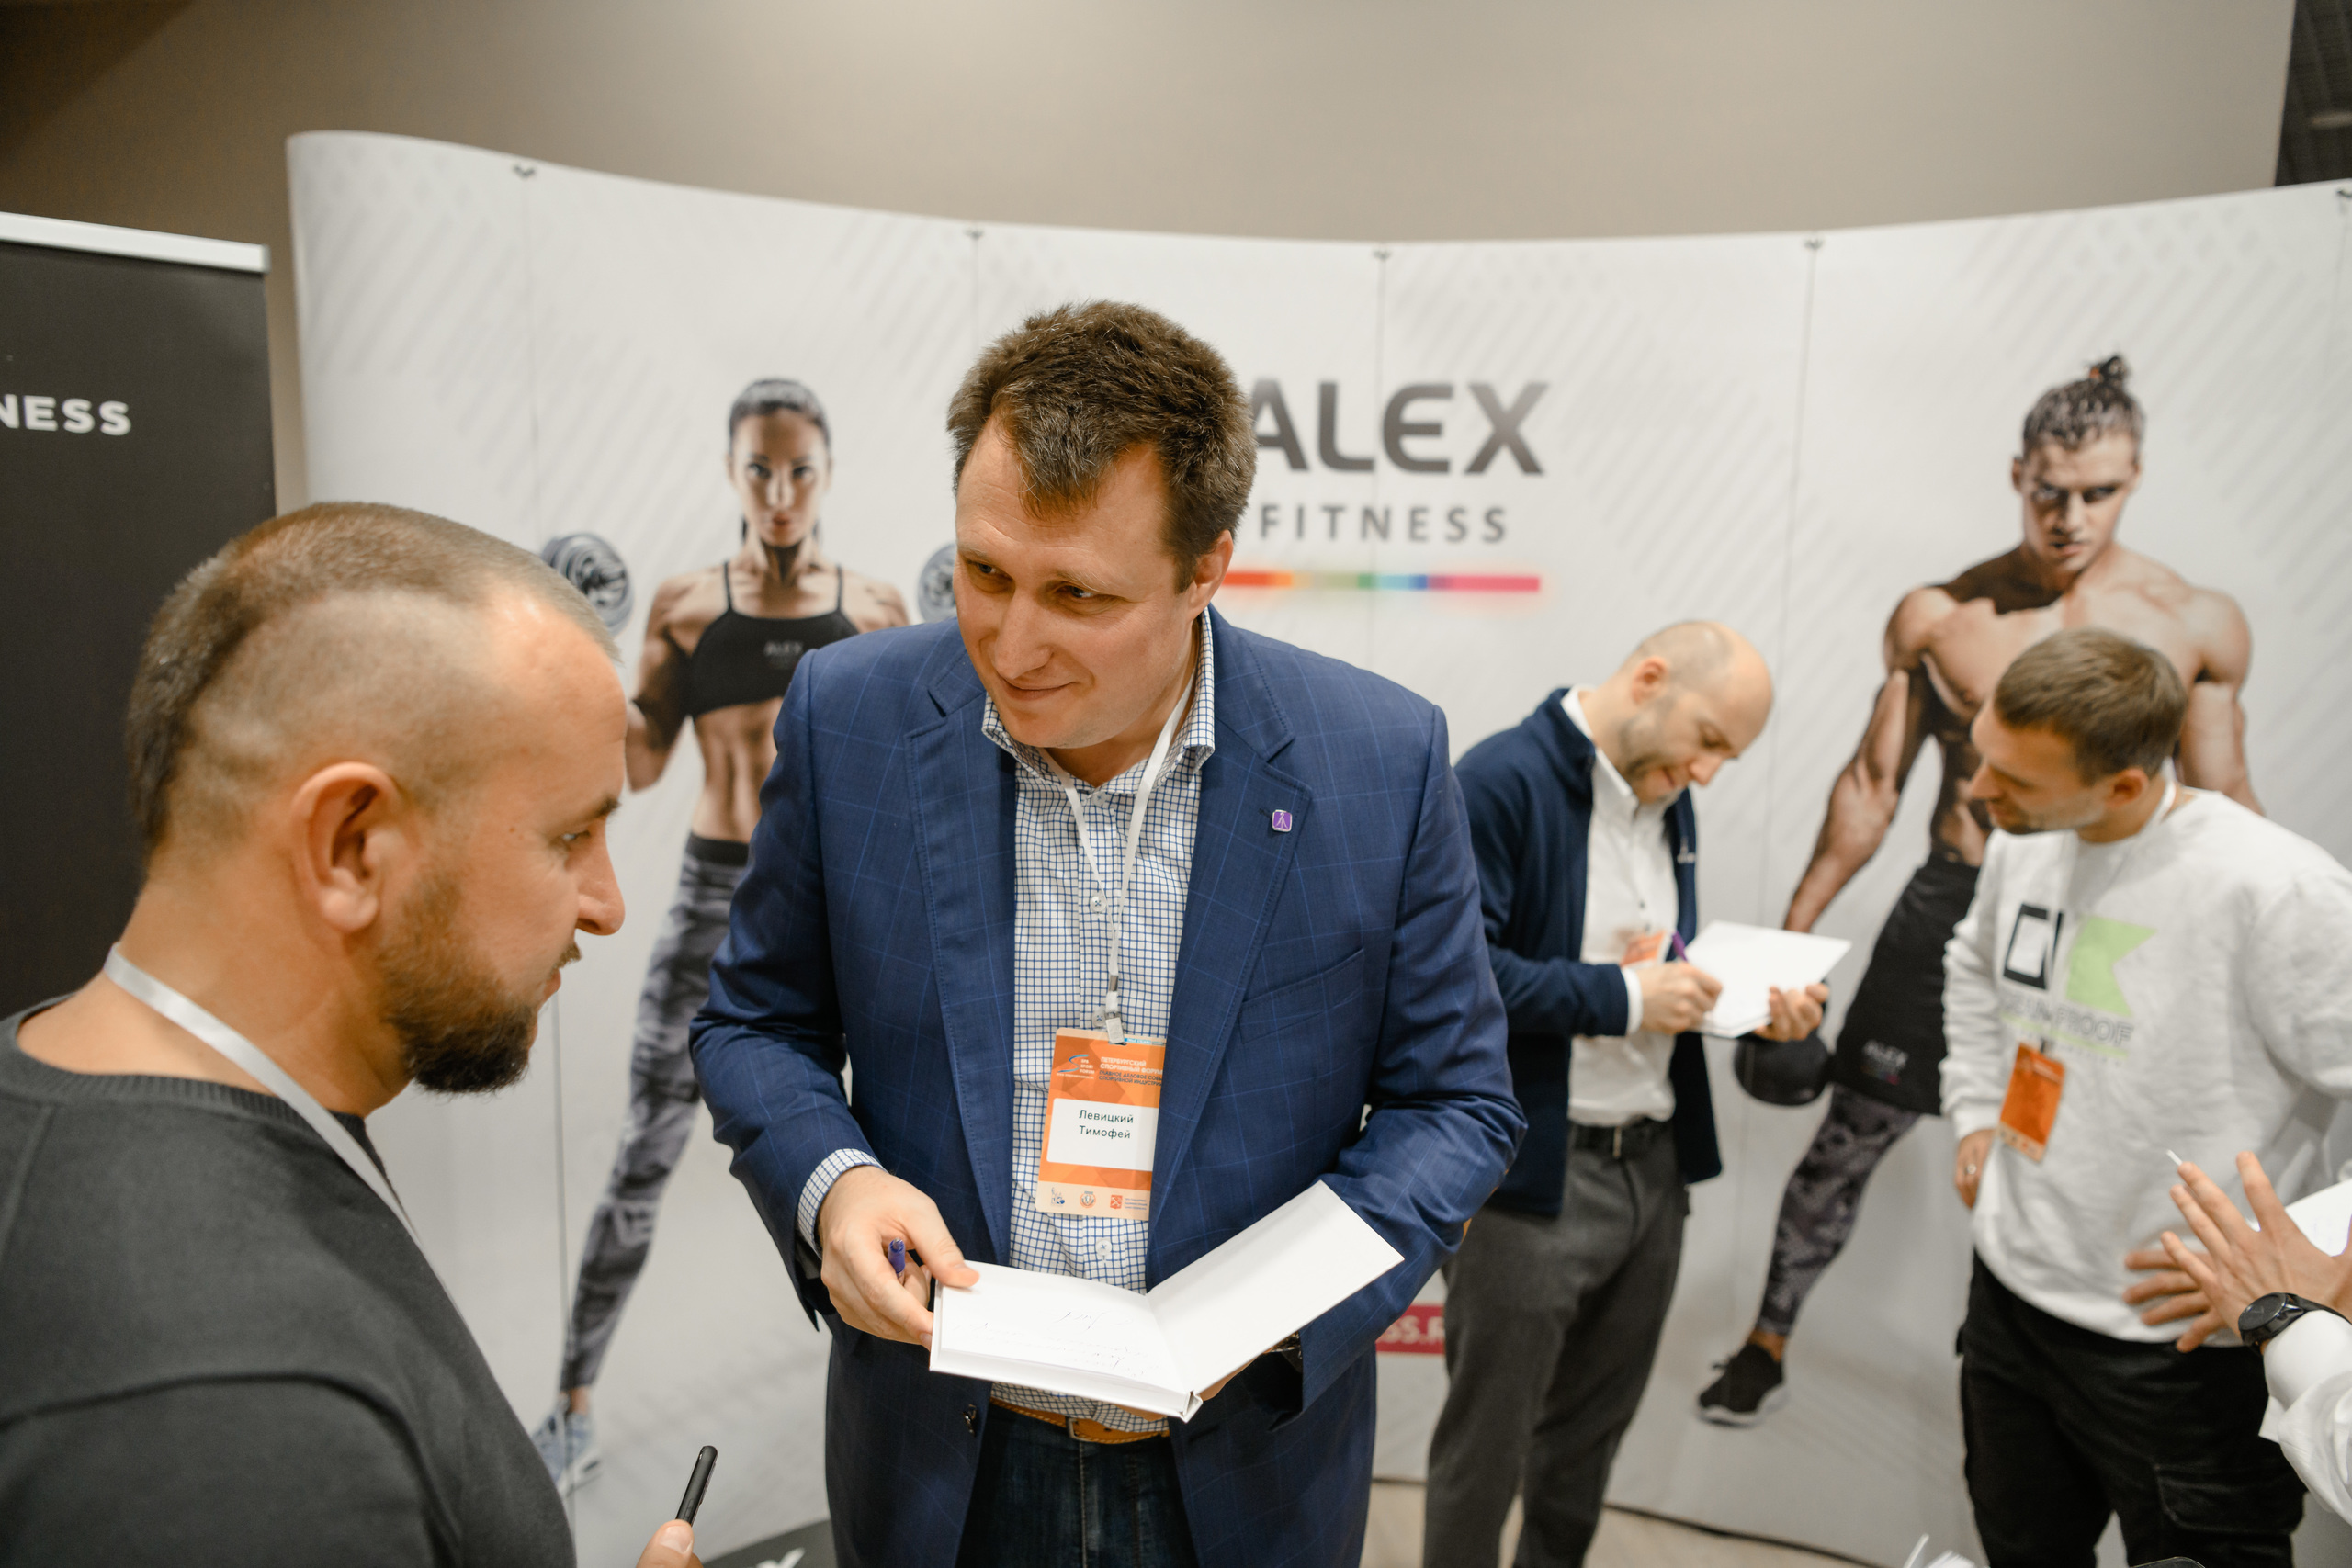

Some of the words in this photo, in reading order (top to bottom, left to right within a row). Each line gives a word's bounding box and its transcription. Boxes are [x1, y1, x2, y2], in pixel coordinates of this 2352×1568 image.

[0, 393, 132, 436] NESS
[1251, 378, 1549, 476] ALEX
[1260, 503, 1508, 545] FITNESS
[1079, 1109, 1135, 1123] Левицкий
[1079, 1124, 1131, 1140] Тимофей
